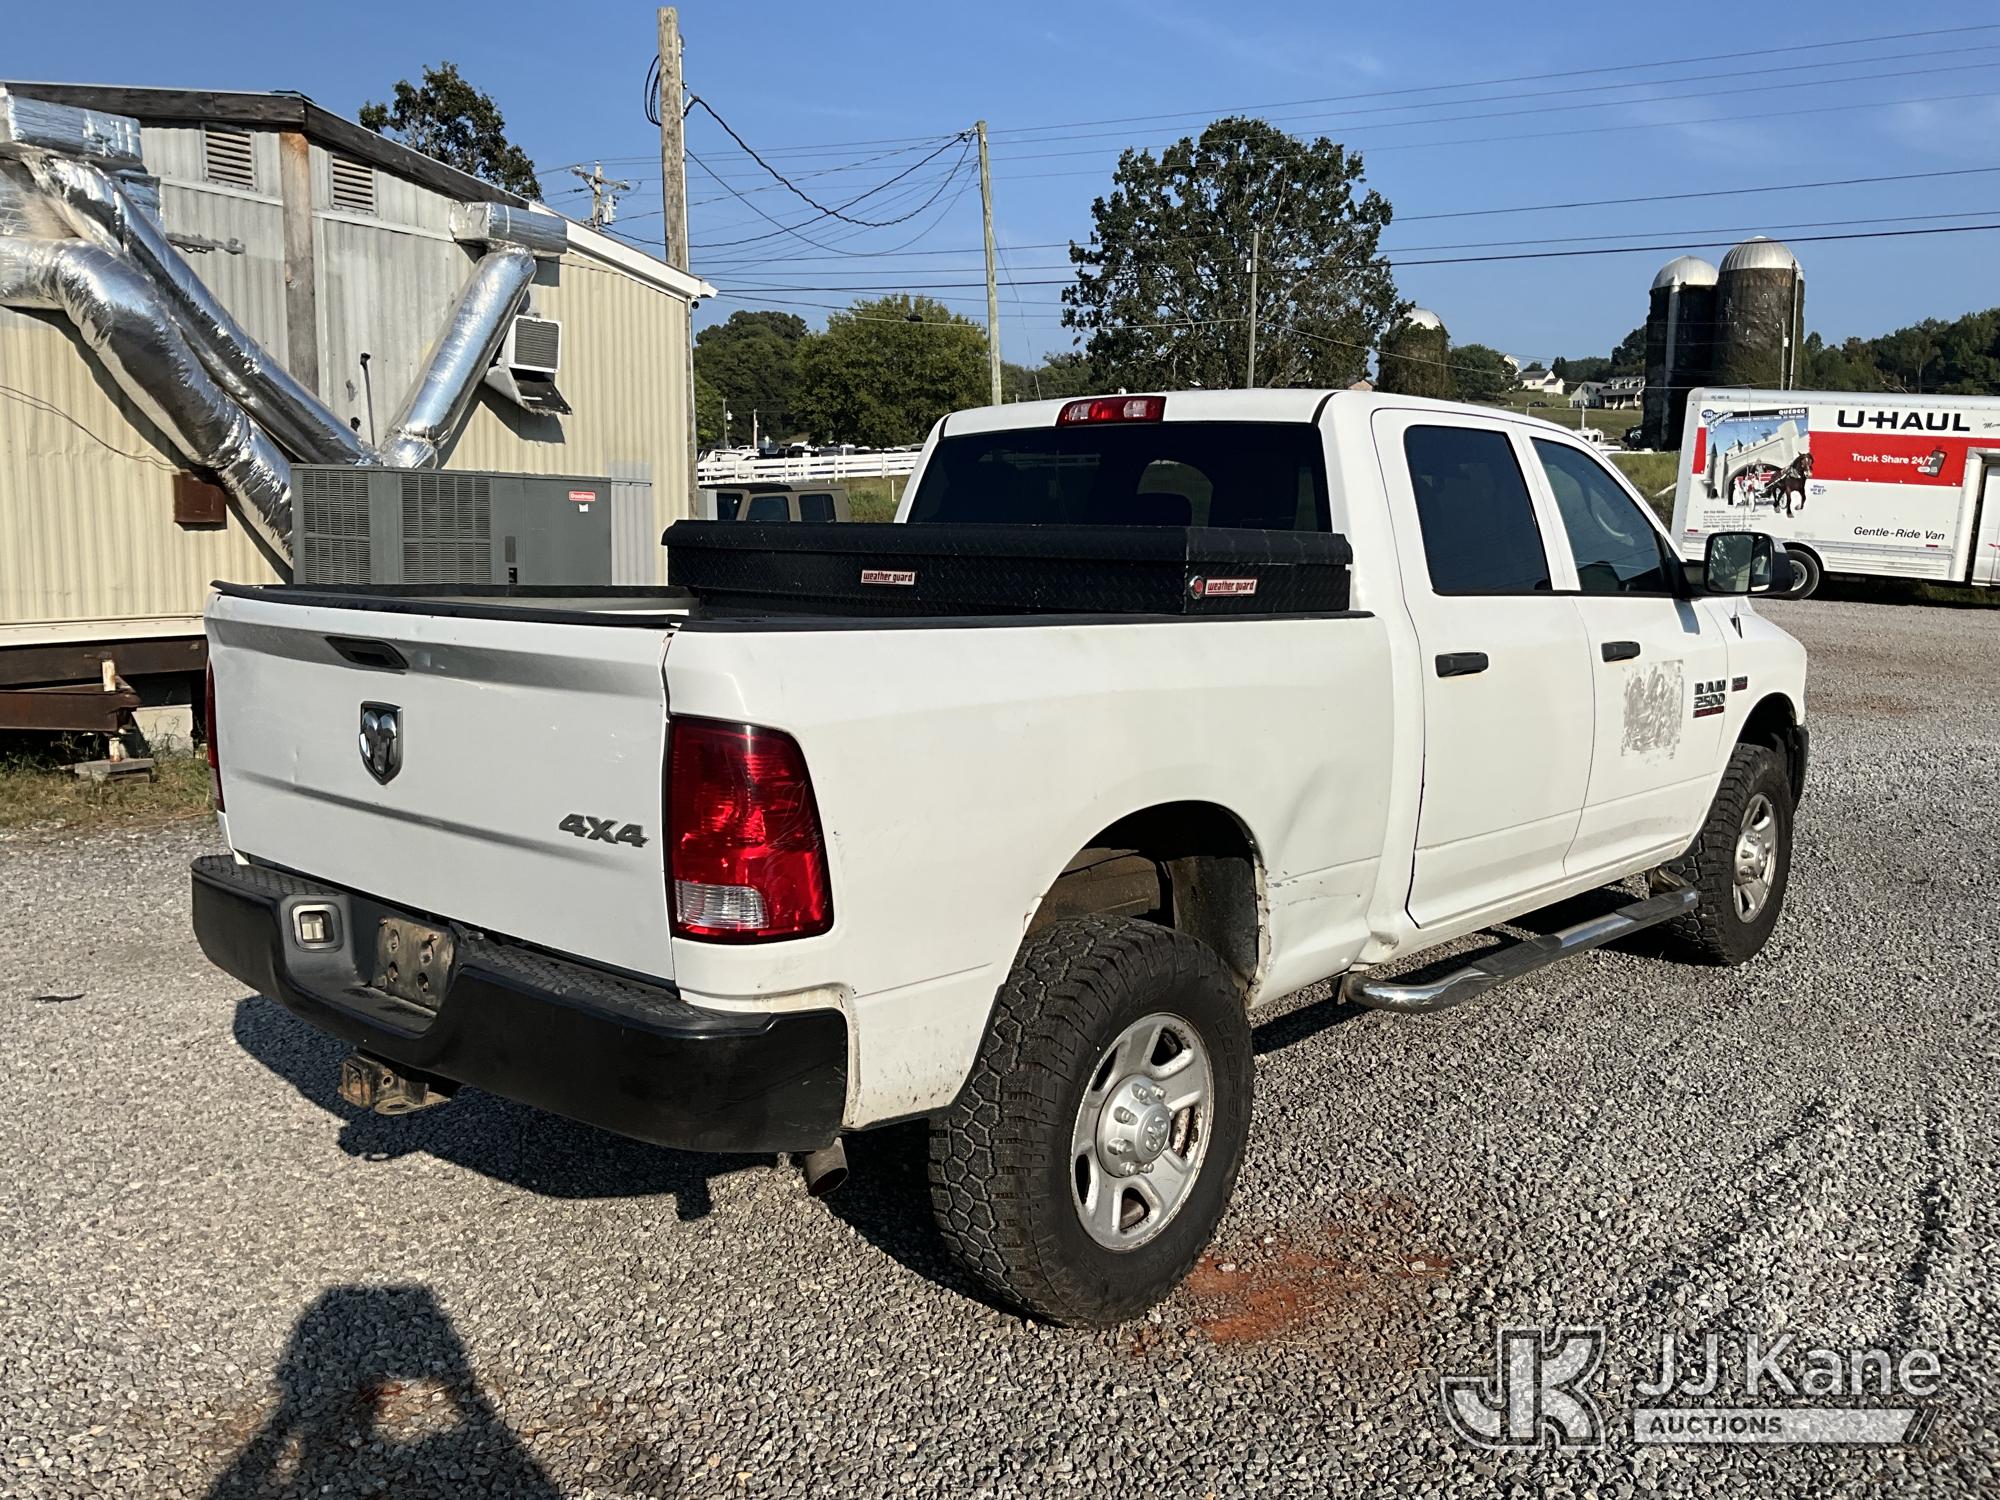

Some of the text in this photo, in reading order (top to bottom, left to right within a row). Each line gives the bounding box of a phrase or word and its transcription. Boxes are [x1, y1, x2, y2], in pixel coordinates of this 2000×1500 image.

[1837, 410, 1970, 431] U-HAUL
[1852, 453, 1934, 465] Truck Share 24/7
[1853, 526, 1945, 540] Gentle-Ride Van
[863, 572, 913, 583] weather guard
[1207, 581, 1255, 591] weather guard
[1694, 680, 1726, 695] RAM
[1693, 693, 1725, 708] 2500
